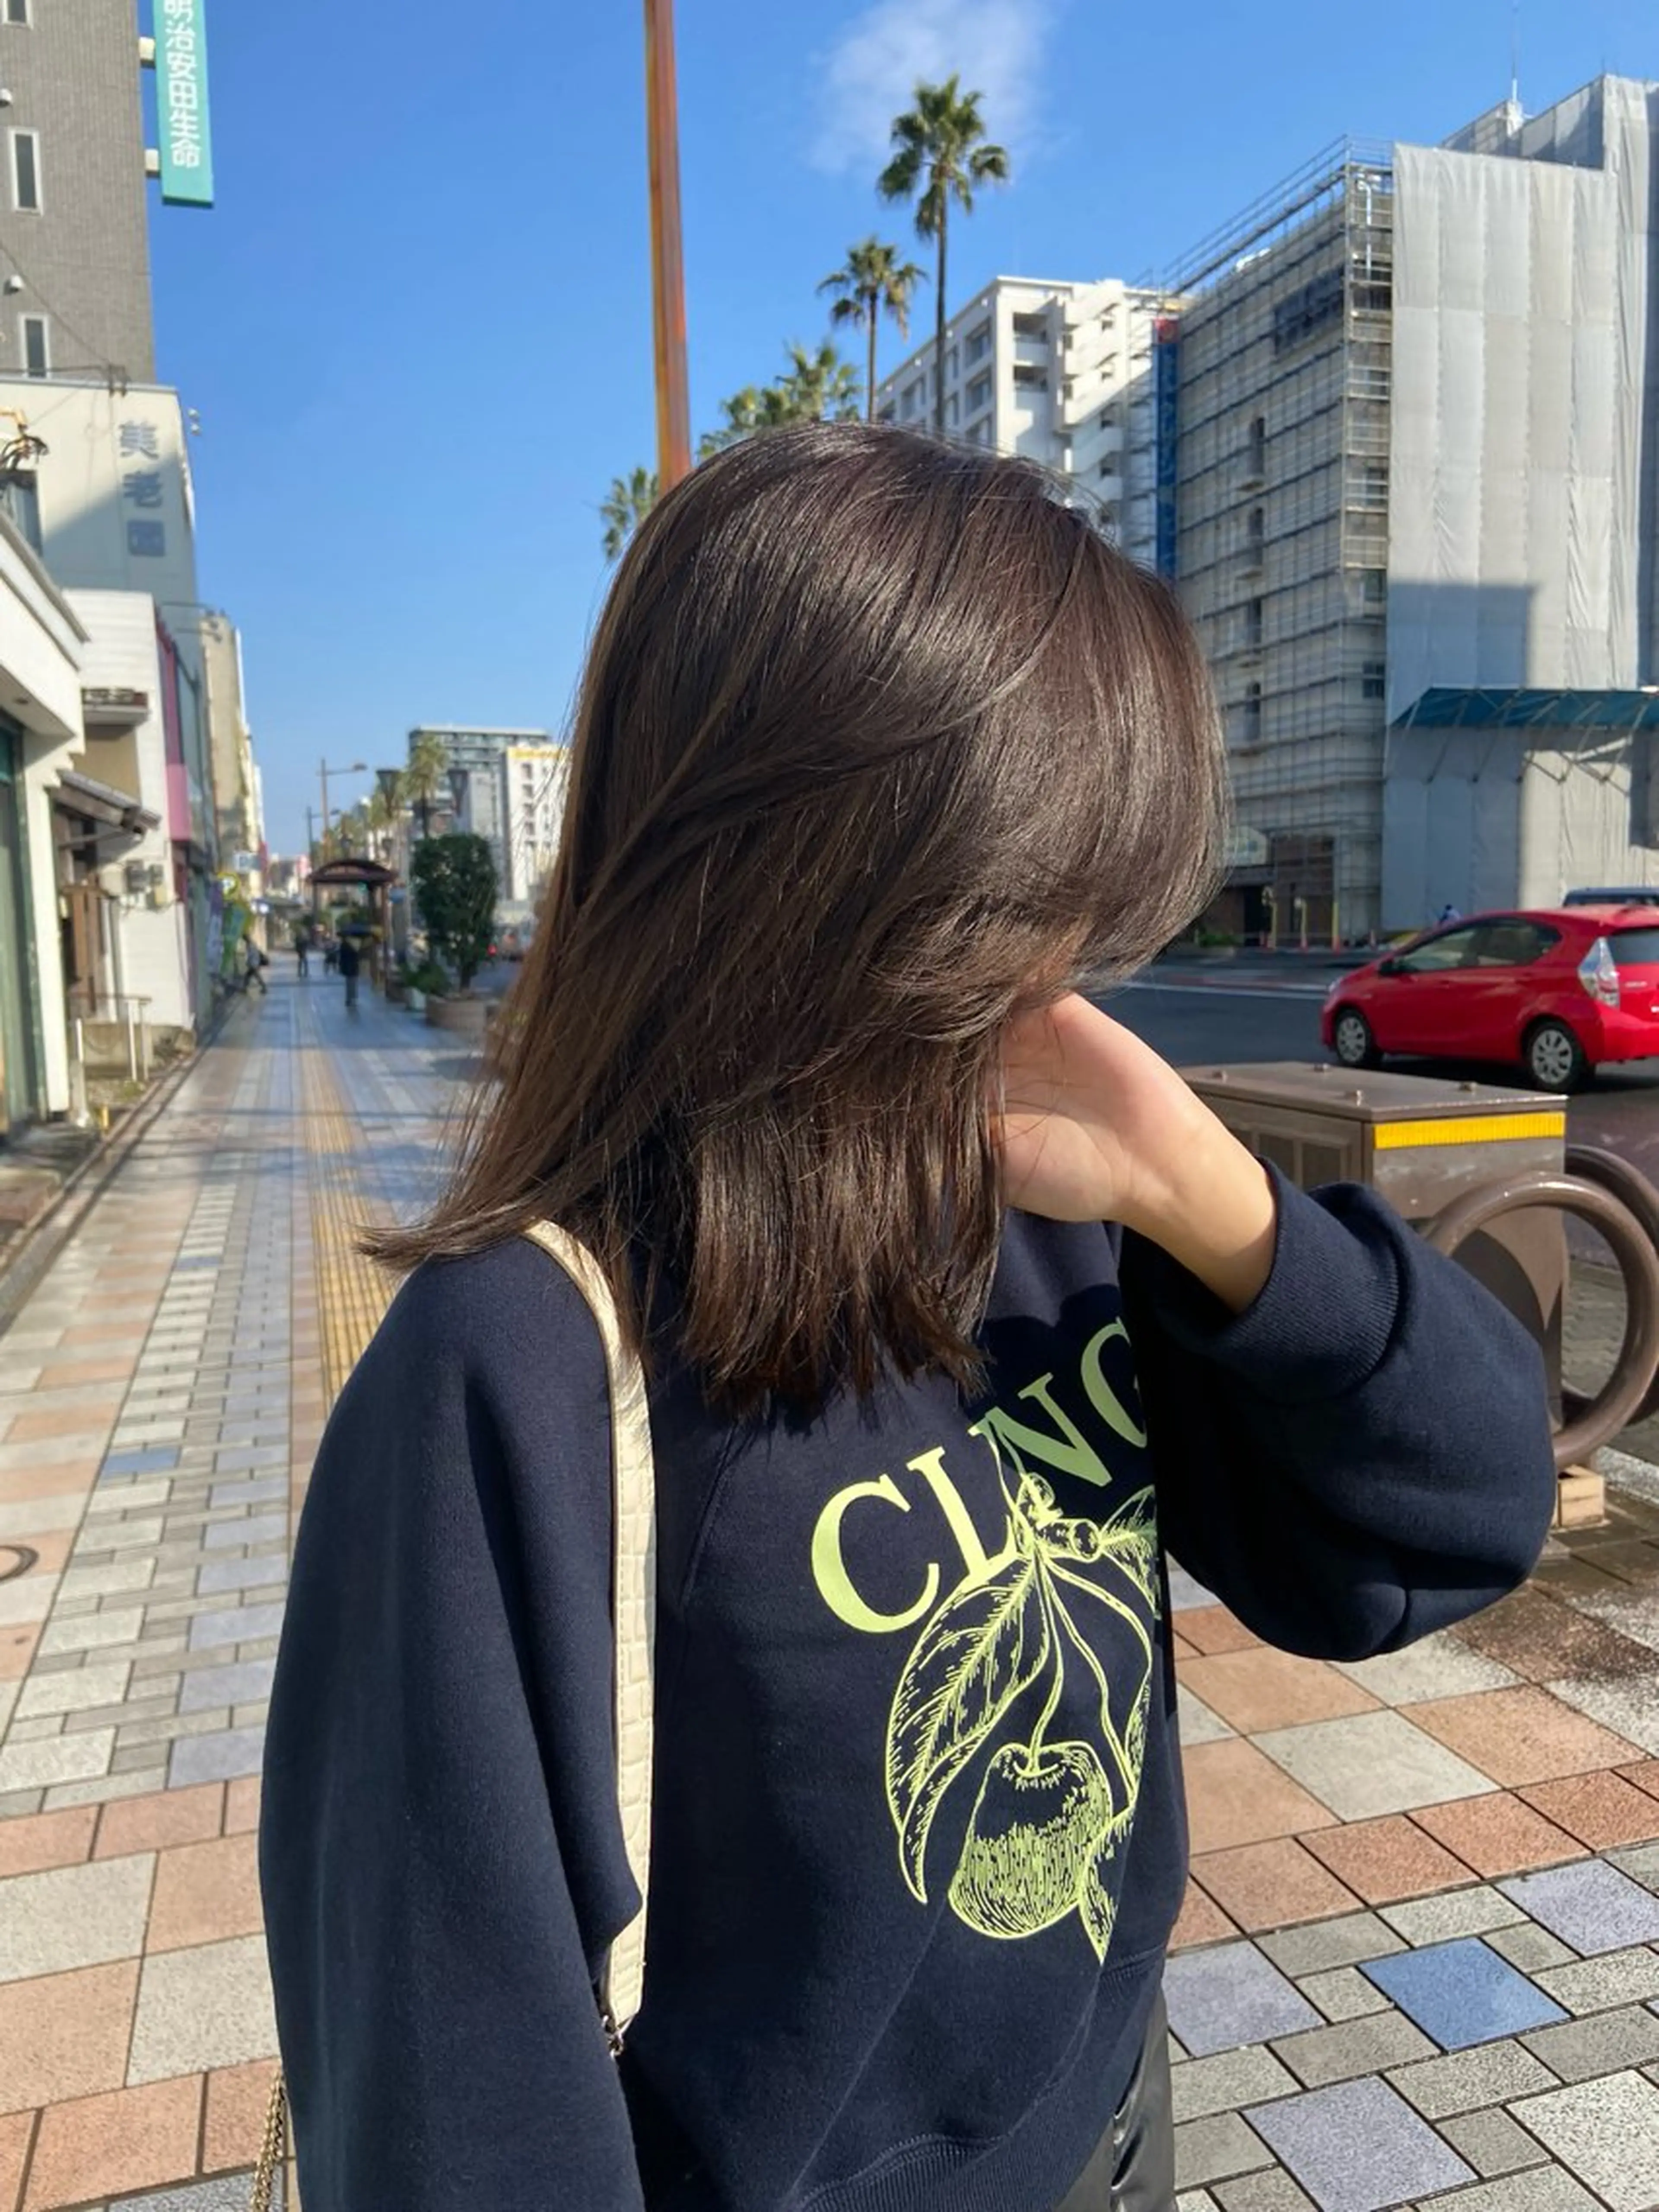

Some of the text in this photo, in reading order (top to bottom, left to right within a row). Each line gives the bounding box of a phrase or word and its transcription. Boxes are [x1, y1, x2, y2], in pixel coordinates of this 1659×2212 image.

[164, 0, 202, 168] 明治安田生命
